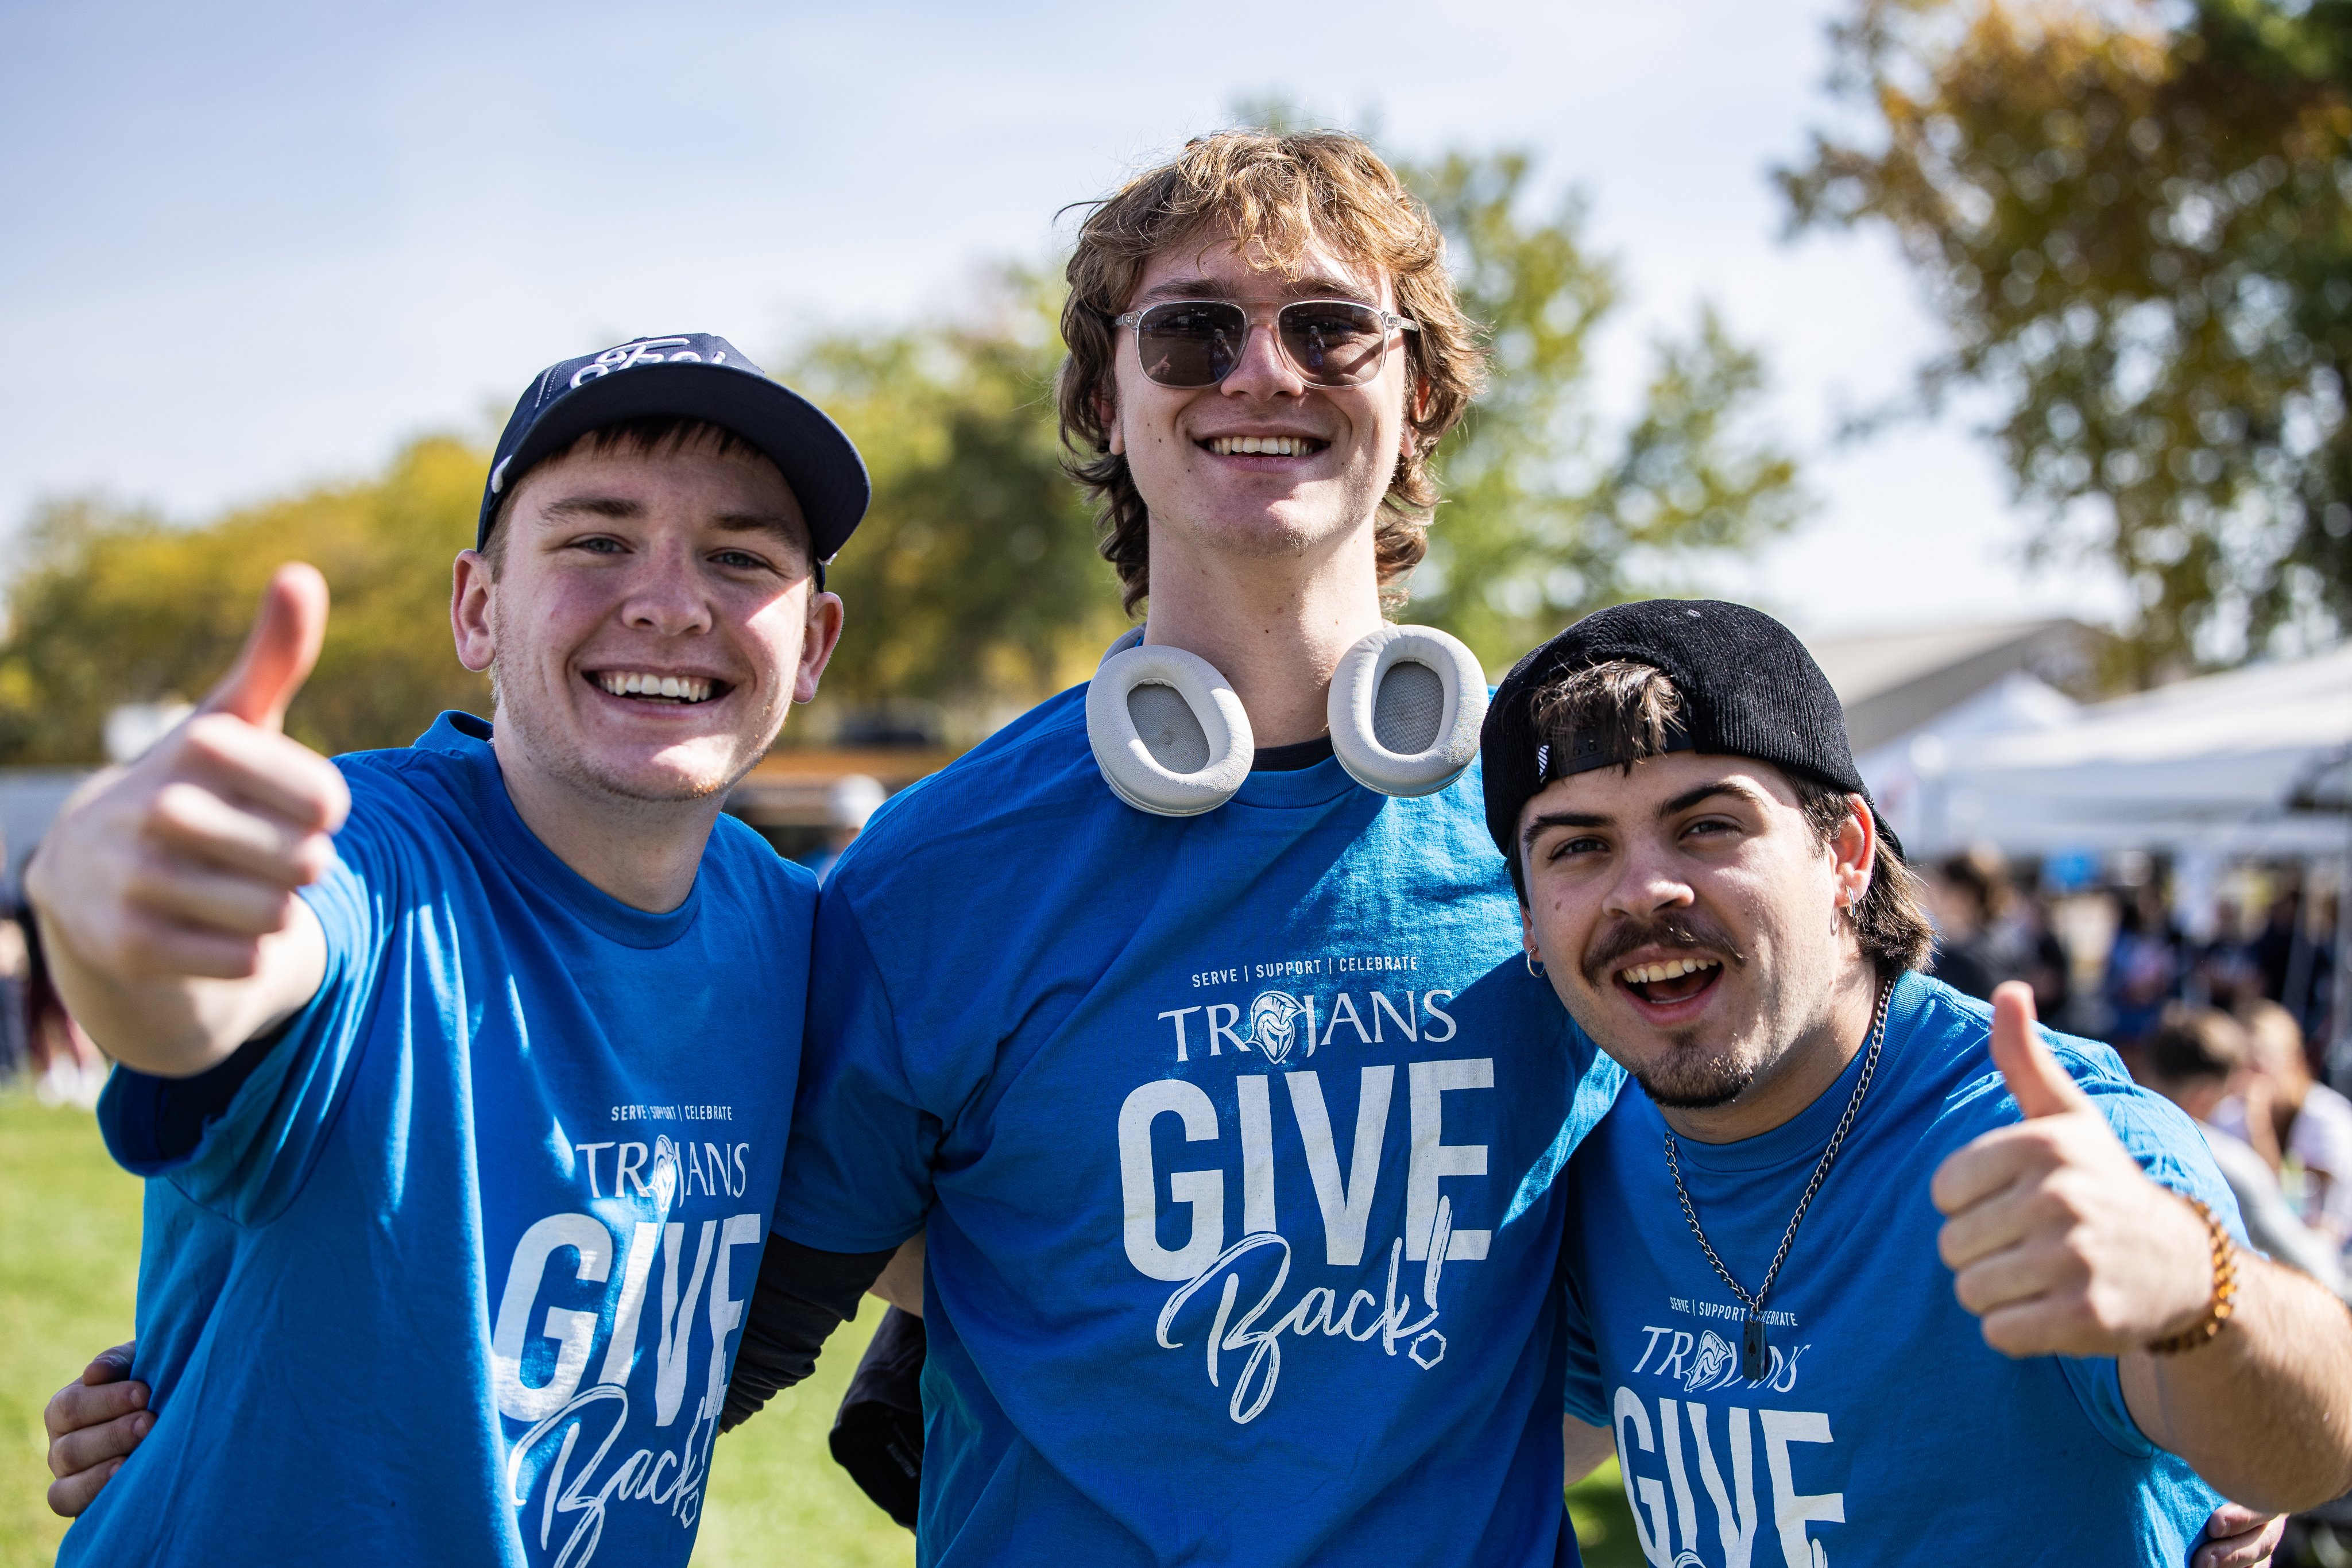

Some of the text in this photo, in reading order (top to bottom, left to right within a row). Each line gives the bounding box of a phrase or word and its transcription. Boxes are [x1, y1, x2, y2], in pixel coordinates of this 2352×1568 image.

[1192, 957, 1418, 988] SERVE SUPPORT CELEBRATE
[611, 1105, 647, 1121] SERVE
[684, 1105, 732, 1121] CELEBRATE
[1118, 1058, 1494, 1281] GIVE
[492, 1213, 761, 1427] GIVE
[1156, 1195, 1453, 1424] Back!
[1670, 1296, 1690, 1314] SERVE
[1699, 1302, 1746, 1322] SUPPORT
[1614, 1386, 1846, 1568] GIVE
